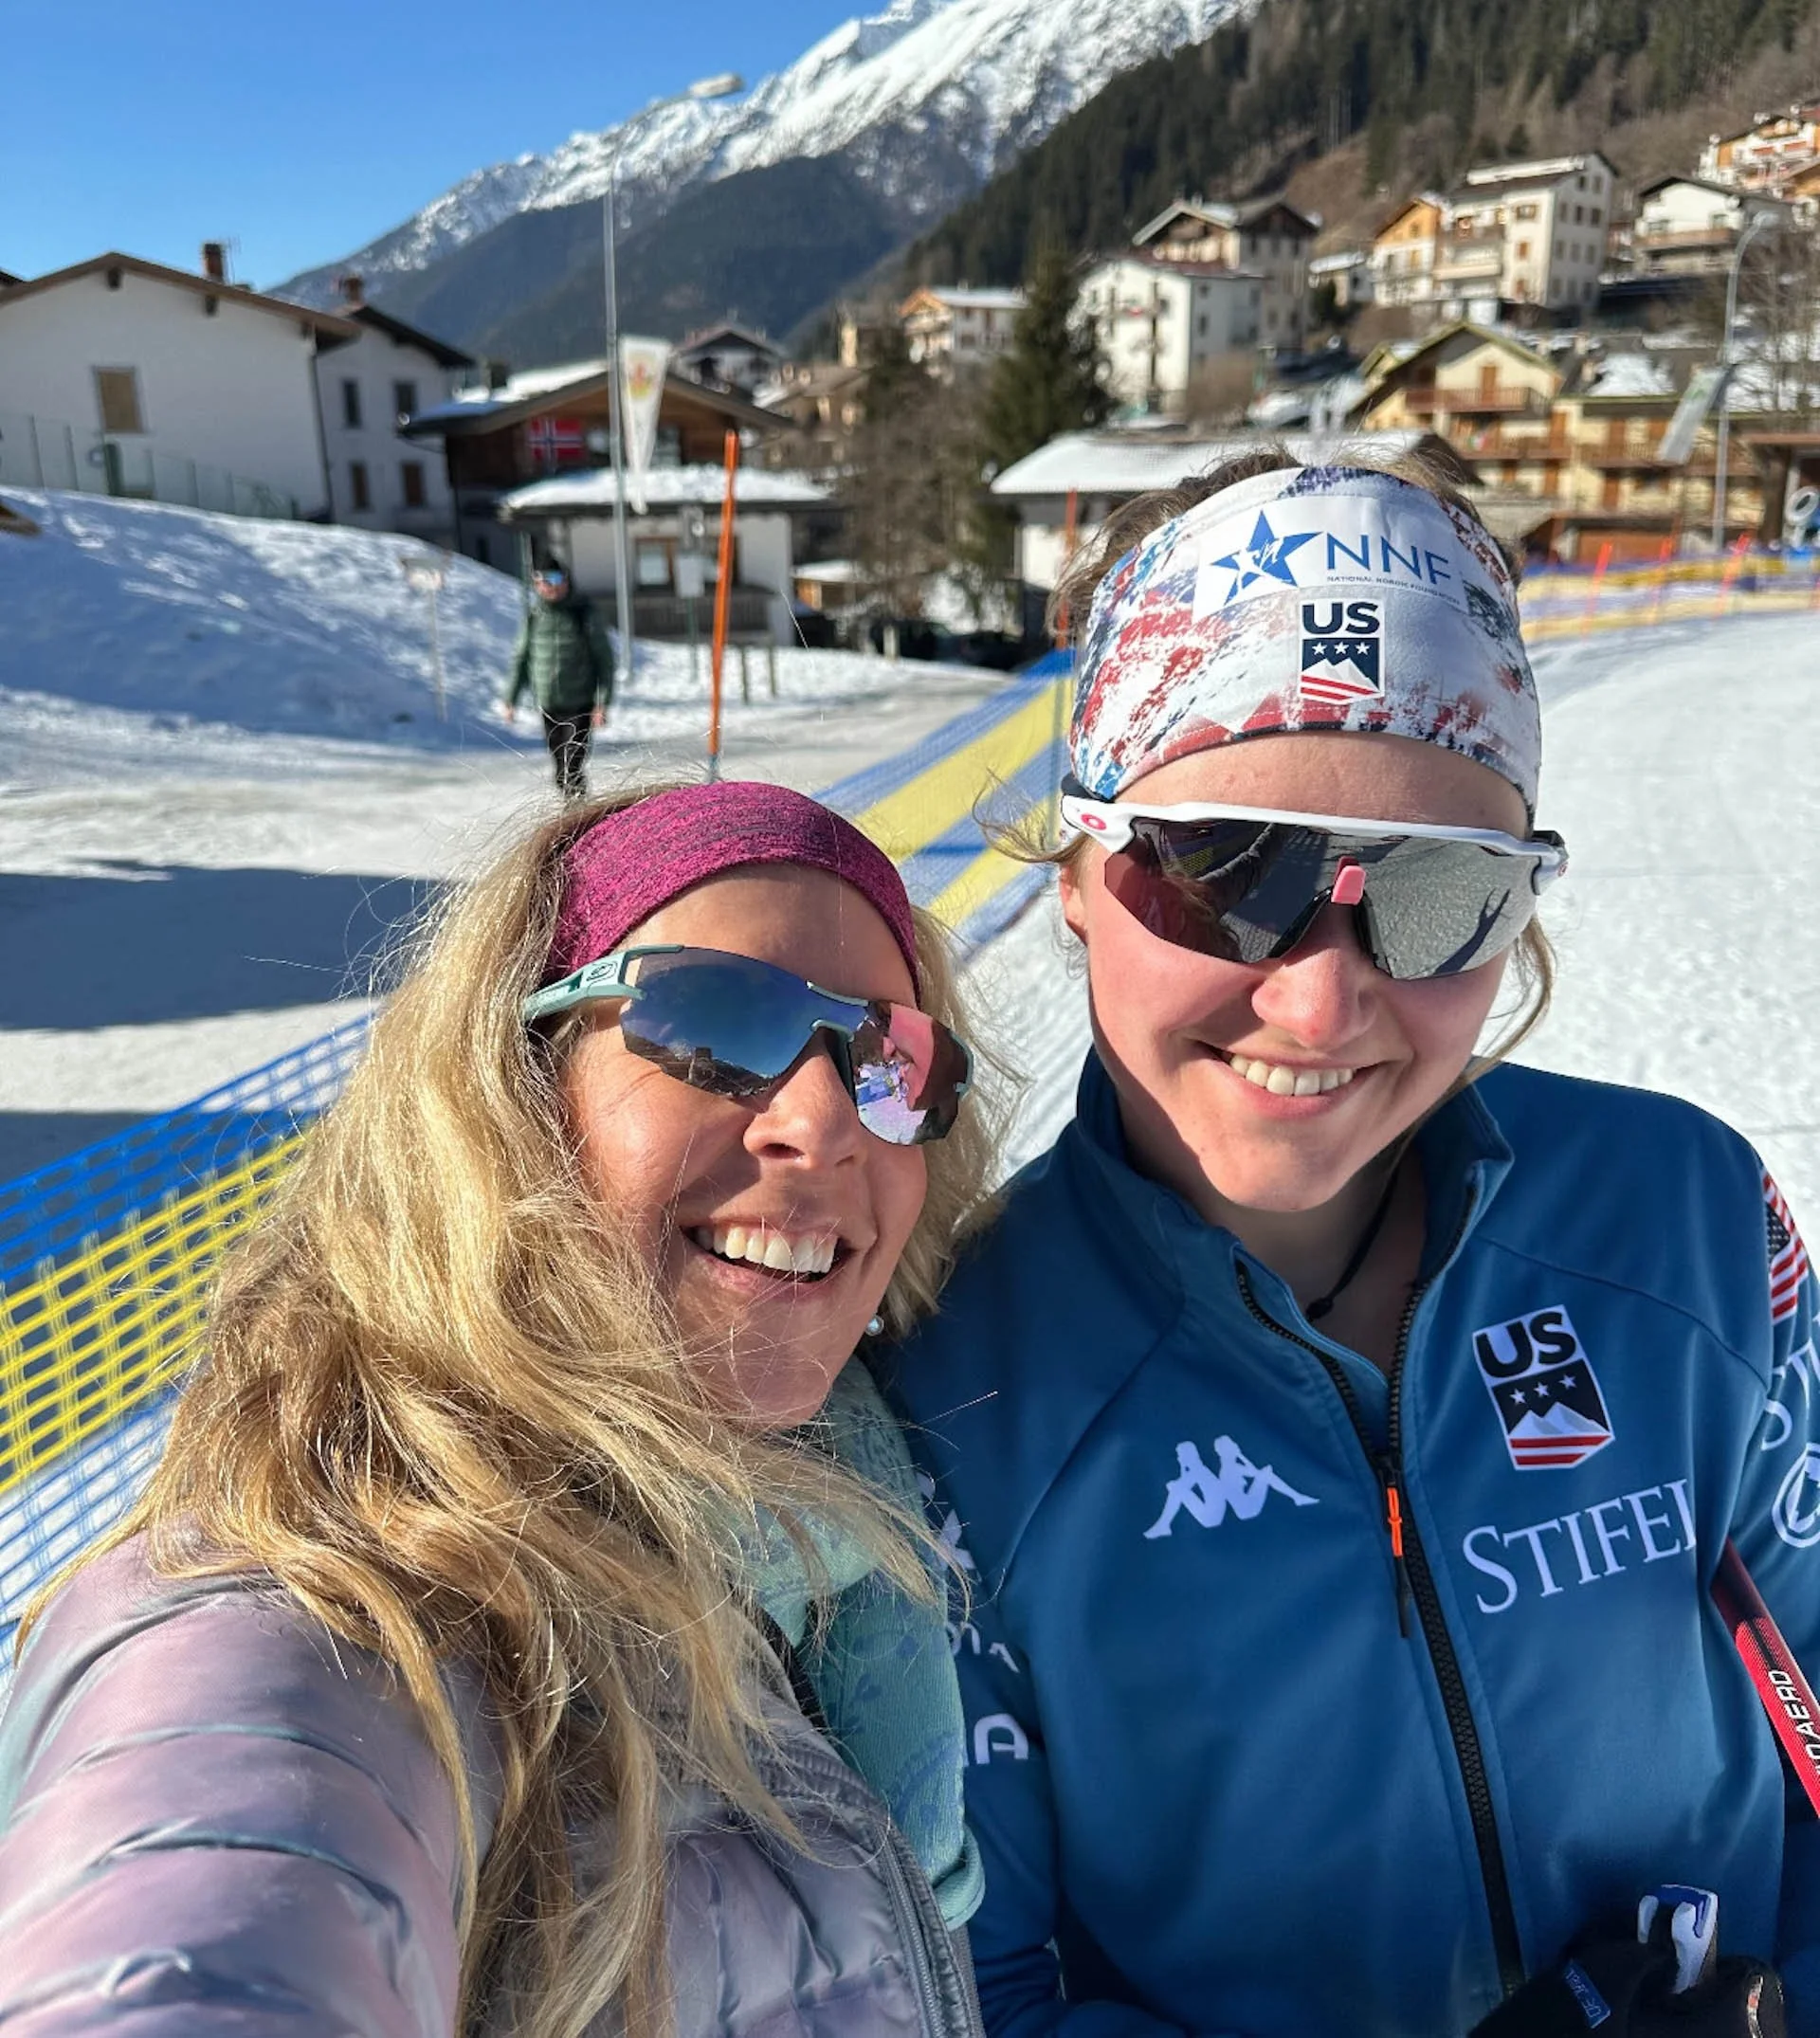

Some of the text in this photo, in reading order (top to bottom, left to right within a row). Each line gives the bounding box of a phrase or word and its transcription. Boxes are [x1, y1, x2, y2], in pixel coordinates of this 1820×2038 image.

[1327, 532, 1451, 584] NNF
[1302, 601, 1378, 634] US
[1476, 1311, 1576, 1377] US
